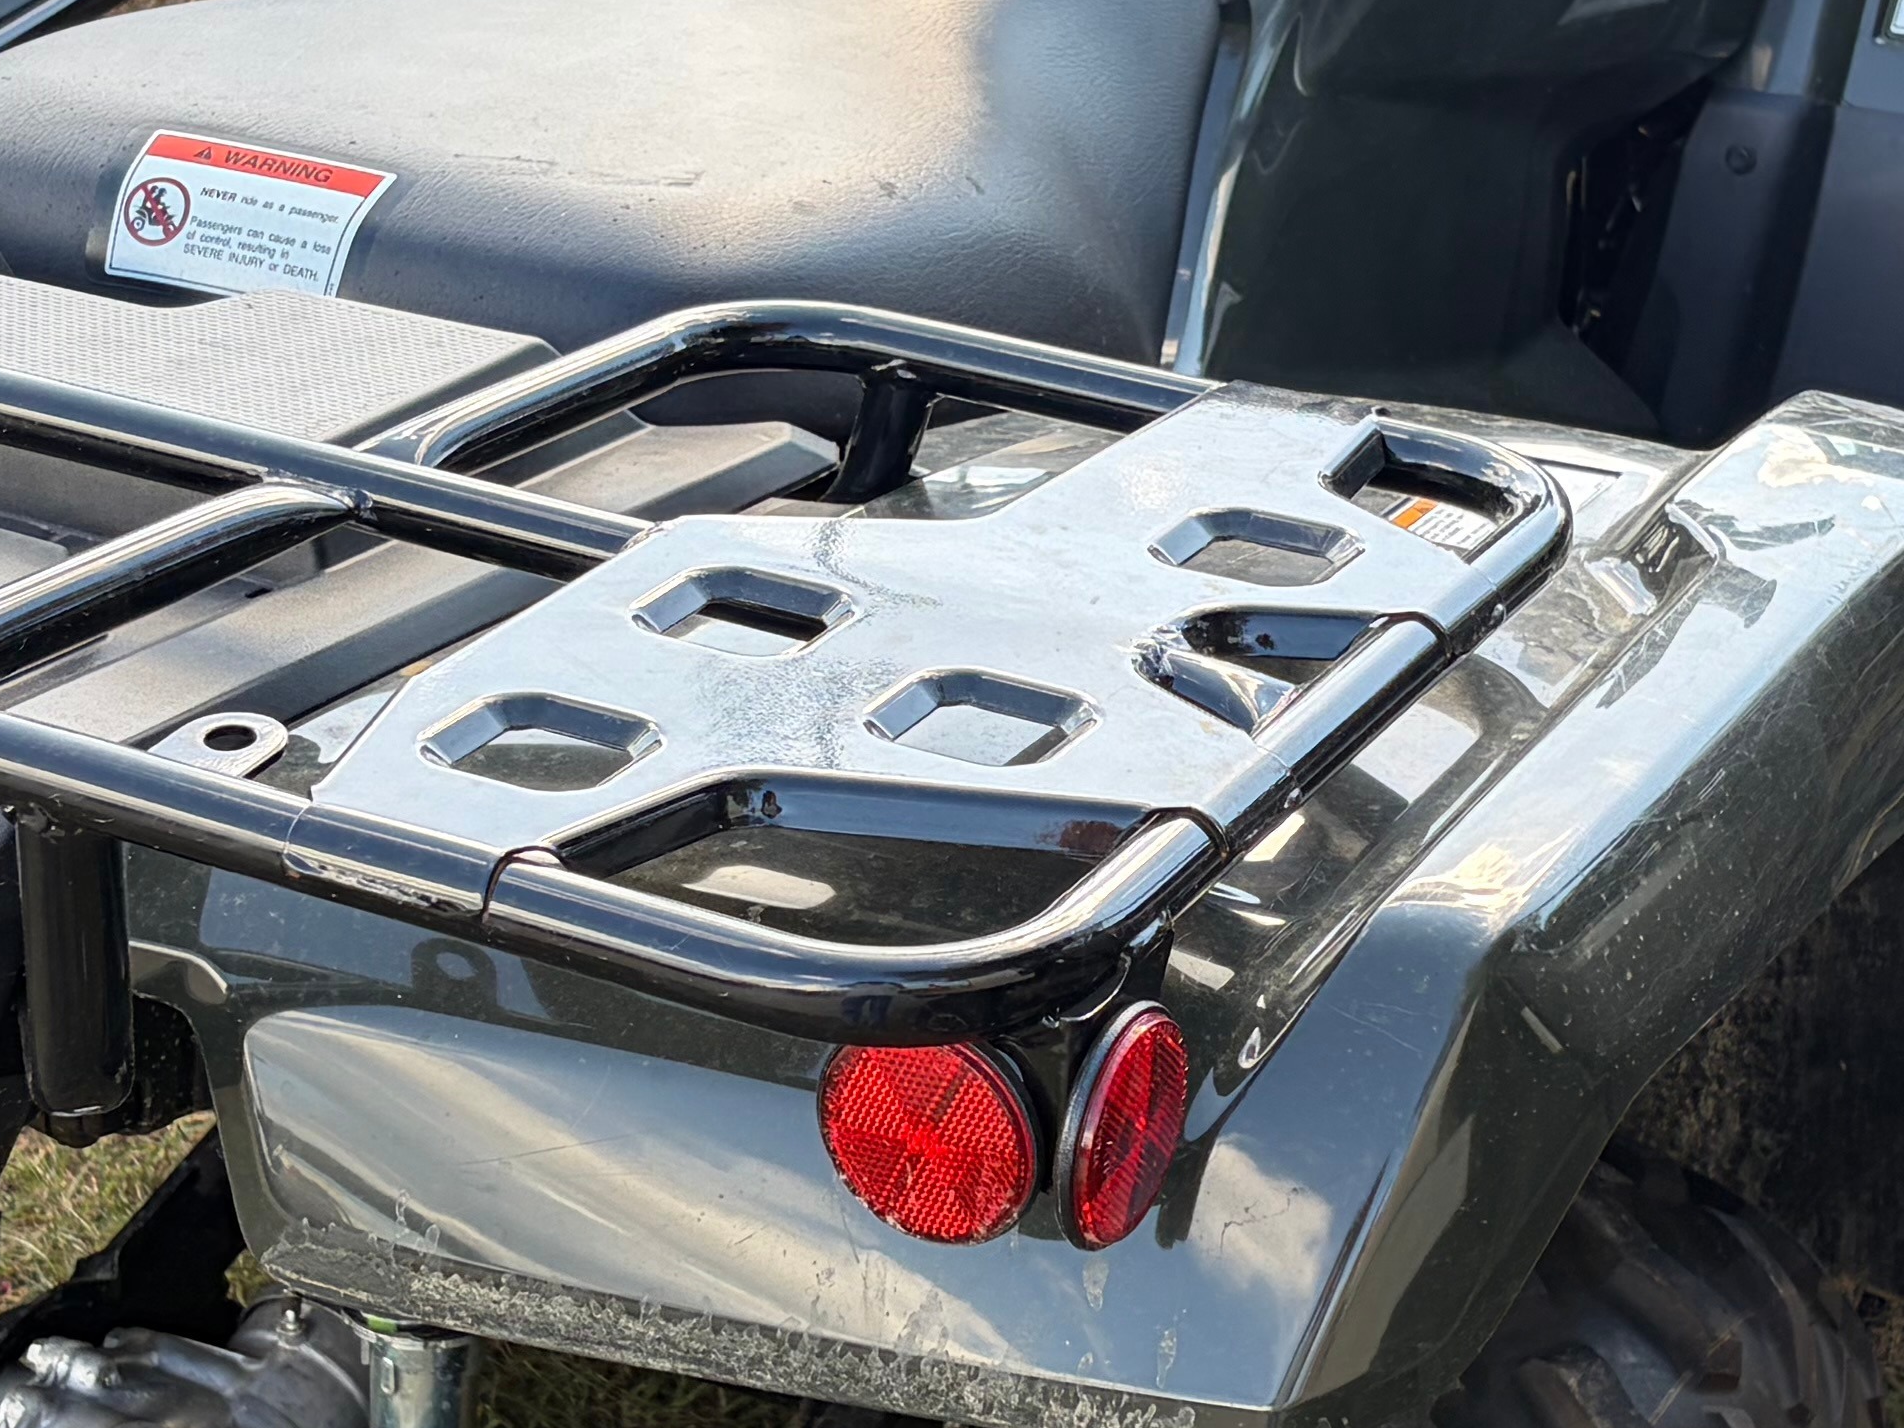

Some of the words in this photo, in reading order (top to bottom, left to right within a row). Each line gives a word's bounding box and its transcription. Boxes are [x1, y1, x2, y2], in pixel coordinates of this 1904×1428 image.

[223, 149, 334, 184] WARNING
[199, 186, 238, 203] NEVER
[240, 195, 259, 209] ride
[262, 199, 275, 210] as
[278, 202, 286, 212] a
[185, 229, 196, 241] of
[237, 240, 277, 259] resulting
[280, 247, 290, 260] in
[189, 215, 244, 238] Passengers
[246, 228, 265, 241] can
[268, 232, 297, 247] cause
[300, 240, 308, 250] a
[312, 240, 332, 256] loss
[183, 243, 224, 262] SEVERE
[228, 250, 264, 270] INJURY
[268, 262, 279, 272] or
